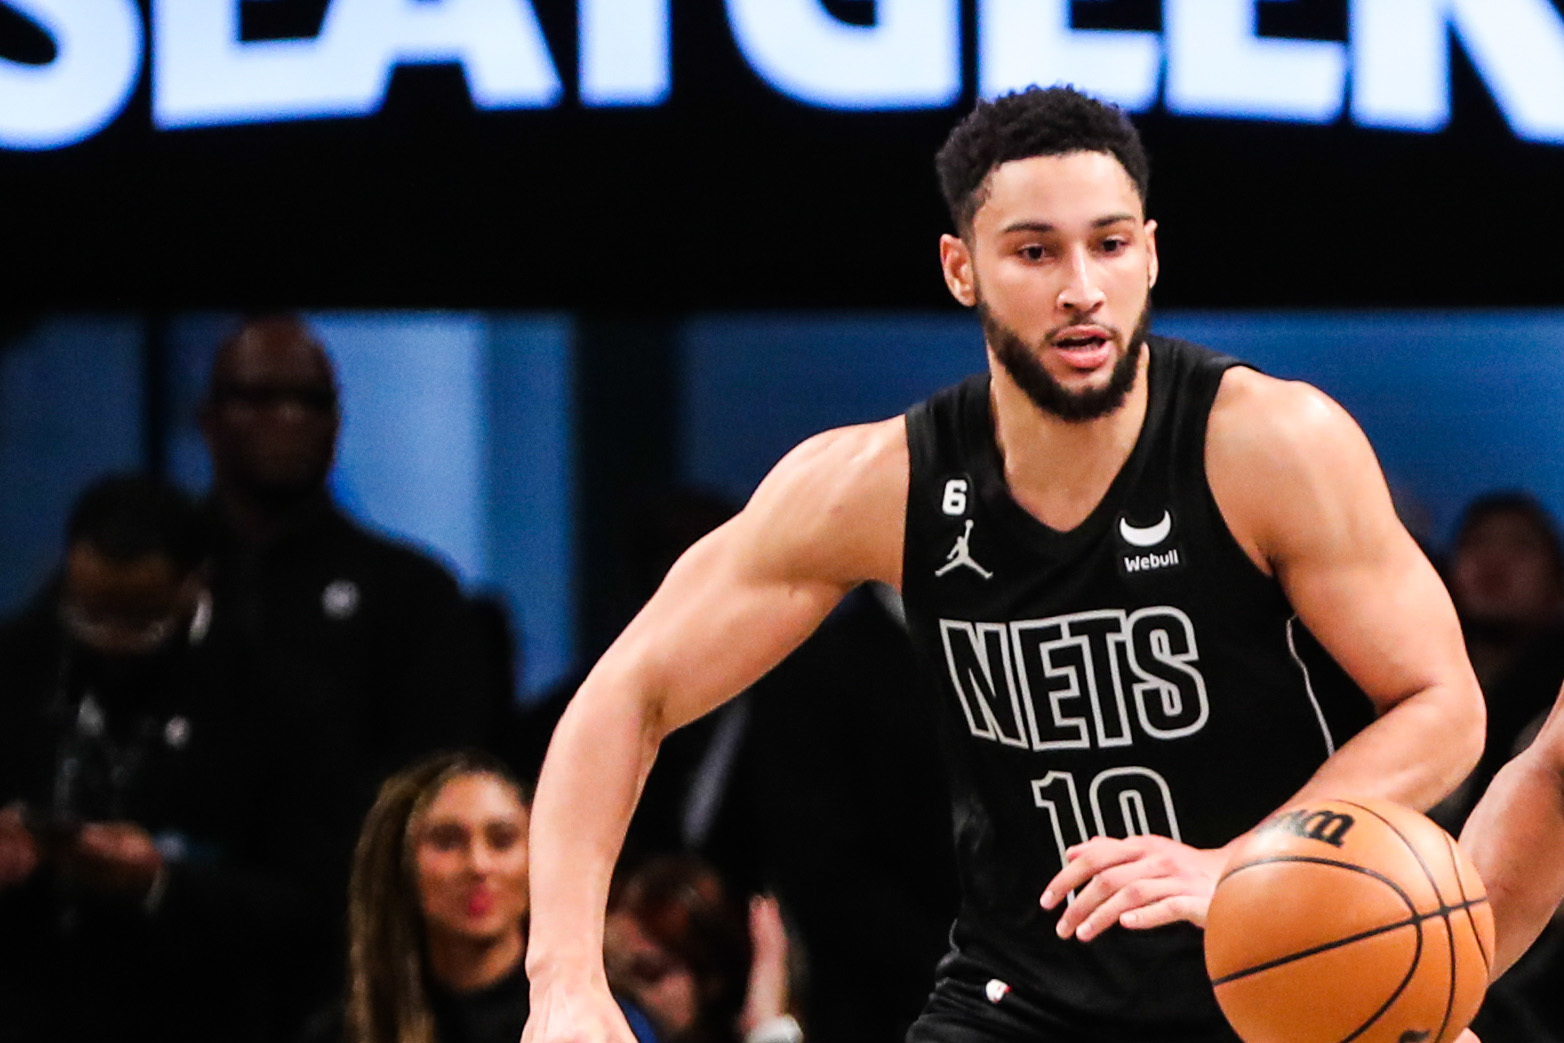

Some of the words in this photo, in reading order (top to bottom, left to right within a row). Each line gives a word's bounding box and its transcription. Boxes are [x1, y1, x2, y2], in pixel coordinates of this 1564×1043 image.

[942, 478, 968, 516] 6
[1123, 549, 1180, 573] Webull
[939, 605, 1210, 752] NETS
